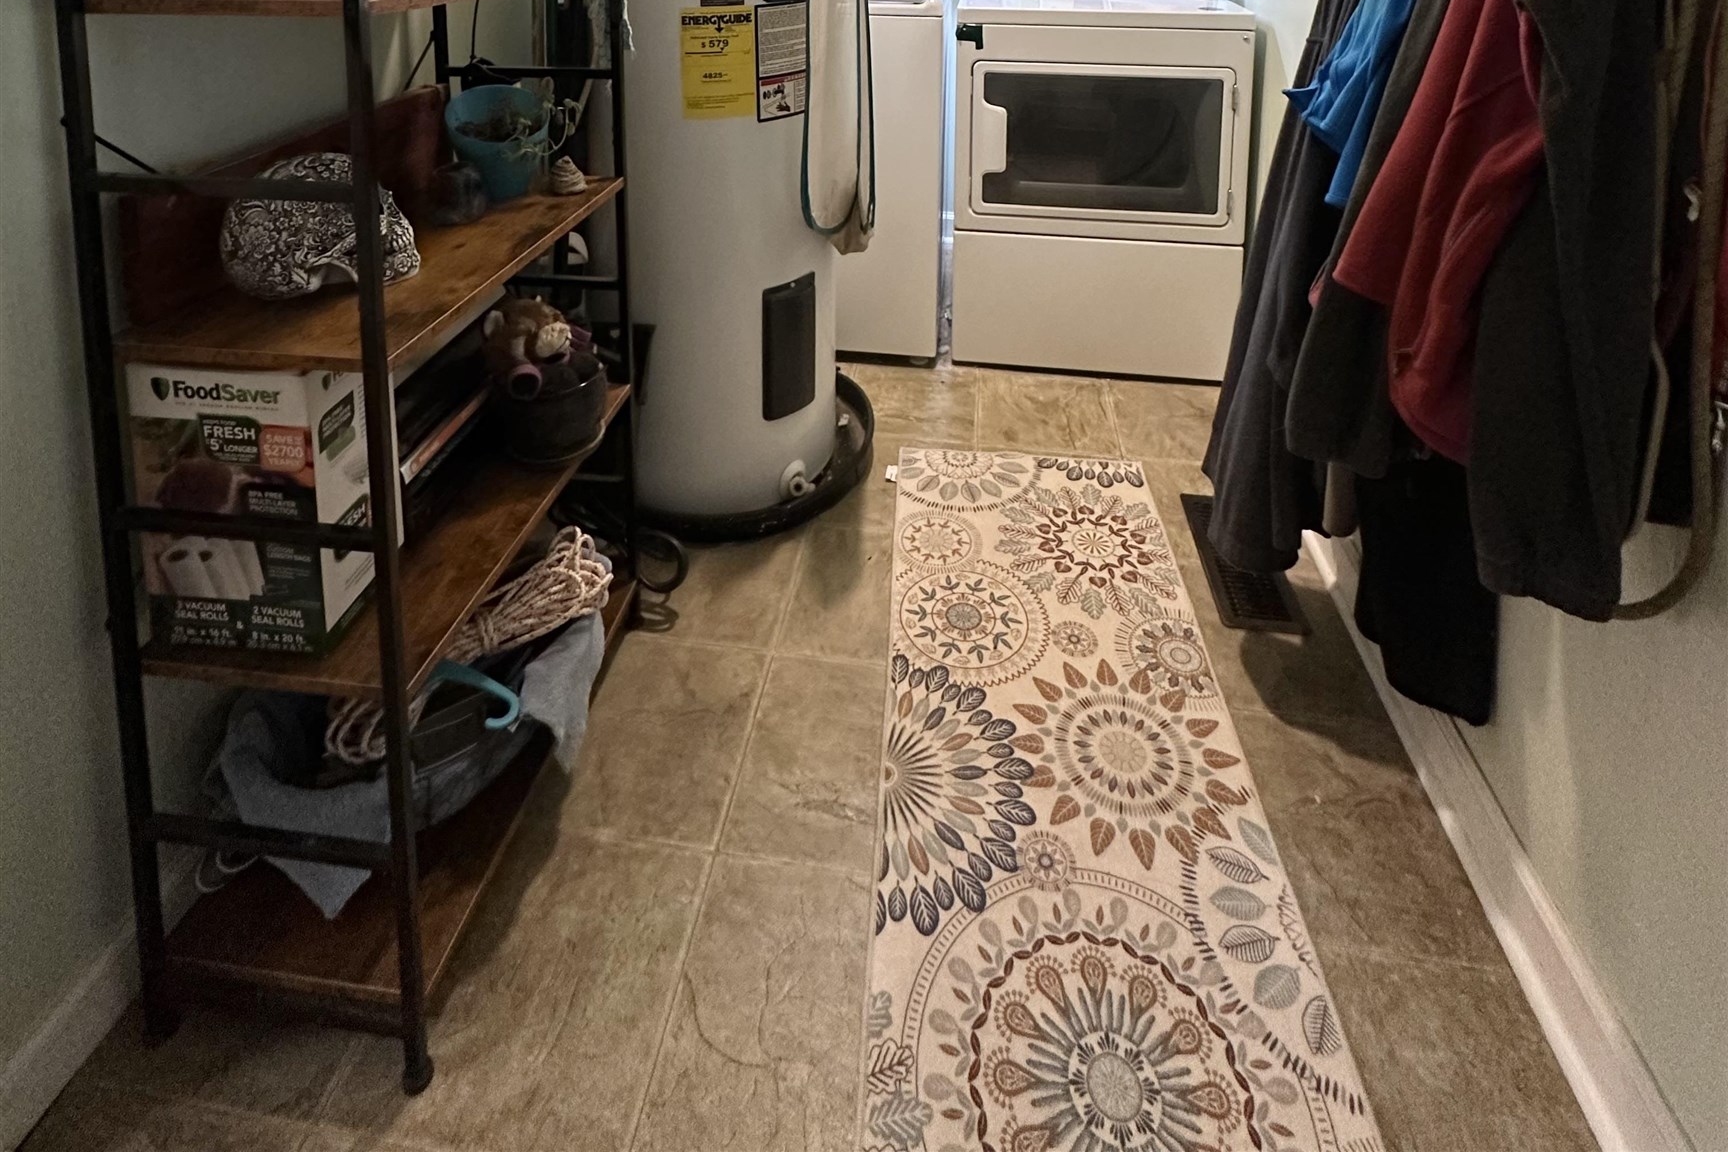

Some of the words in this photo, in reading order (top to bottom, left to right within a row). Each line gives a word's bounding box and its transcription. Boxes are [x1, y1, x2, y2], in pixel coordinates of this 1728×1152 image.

[681, 13, 752, 27] ENERGYGUIDE
[709, 39, 729, 48] 579
[172, 380, 281, 404] FoodSaver
[203, 425, 256, 441] FRESH
[265, 434, 292, 445] SAVE
[223, 445, 258, 454] LONGER
[184, 600, 227, 612] VACUUM
[253, 605, 259, 614] 2
[260, 606, 302, 619] VACUUM
[200, 611, 229, 622] ROLLS
[251, 615, 275, 626] SEAL
[276, 617, 305, 629] ROLLS
[282, 633, 293, 642] 20
